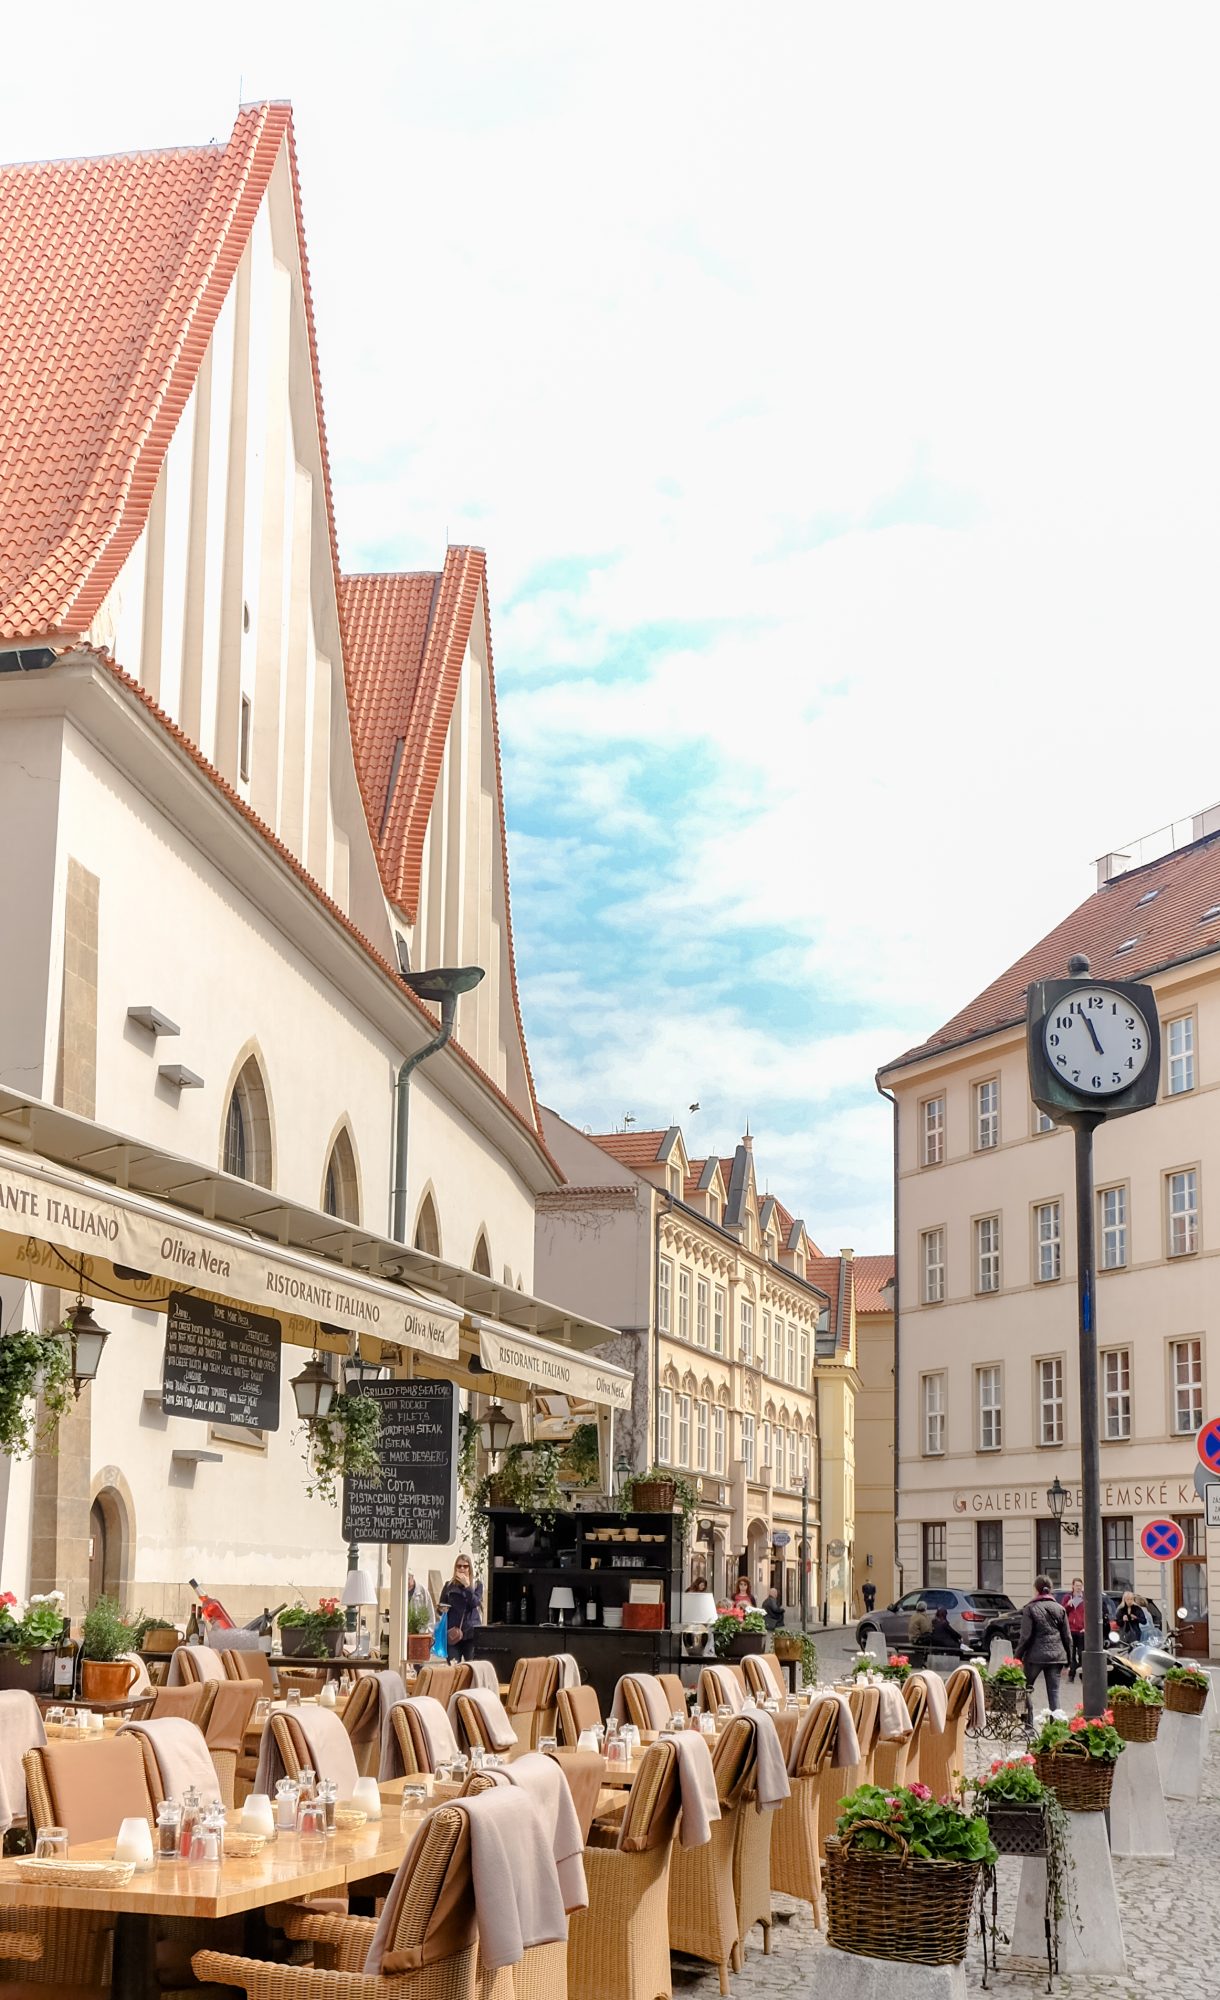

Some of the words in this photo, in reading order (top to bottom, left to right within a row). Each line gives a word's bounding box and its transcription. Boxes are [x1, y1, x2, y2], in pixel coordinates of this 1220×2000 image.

[1069, 1002, 1082, 1014] 11
[1088, 997, 1103, 1009] 12
[1111, 1003, 1117, 1015] 1
[1056, 1017, 1073, 1029] 10
[1124, 1018, 1135, 1030] 2
[1049, 1034, 1060, 1047] 9
[1131, 1038, 1142, 1050] 3
[1056, 1054, 1067, 1066] 8
[1124, 1056, 1135, 1069] 4
[1072, 1069, 1081, 1083] 7
[1092, 1075, 1102, 1088] 6
[1112, 1072, 1122, 1084] 5
[47, 1199, 119, 1241] ITALIANO
[161, 1237, 196, 1267] Oliva
[199, 1249, 231, 1277] Nera
[266, 1271, 331, 1309] RISTORANTE
[335, 1293, 380, 1323] ITALIANO
[404, 1315, 426, 1337] Oliva
[428, 1322, 445, 1343] Nera
[500, 1347, 540, 1373] RISTORANTE
[541, 1361, 570, 1382] ITALIANO
[363, 1386, 395, 1397] GRILLED
[596, 1377, 610, 1394] Oliva
[611, 1382, 625, 1398] Nera
[400, 1400, 431, 1410] ROCKET
[397, 1412, 430, 1423] FILETS
[416, 1424, 443, 1435] STEAK
[385, 1438, 412, 1449] STEAK
[389, 1451, 410, 1462] MADE
[387, 1479, 415, 1492] COTTA
[348, 1491, 396, 1504] PISTACCHIO
[398, 1493, 445, 1507] SEMIFREDDO
[972, 1491, 1037, 1512] GALERIE
[1064, 1481, 1168, 1508] BEÉMSKÉ
[350, 1504, 373, 1515] HOME
[376, 1505, 395, 1516] MADE
[398, 1507, 411, 1517] ICE
[413, 1507, 440, 1519] CREAM
[372, 1517, 414, 1529] PINEAPPLE
[417, 1519, 434, 1530] WITH
[354, 1528, 390, 1539] COCONUT
[391, 1529, 439, 1540] MASCARPONE
